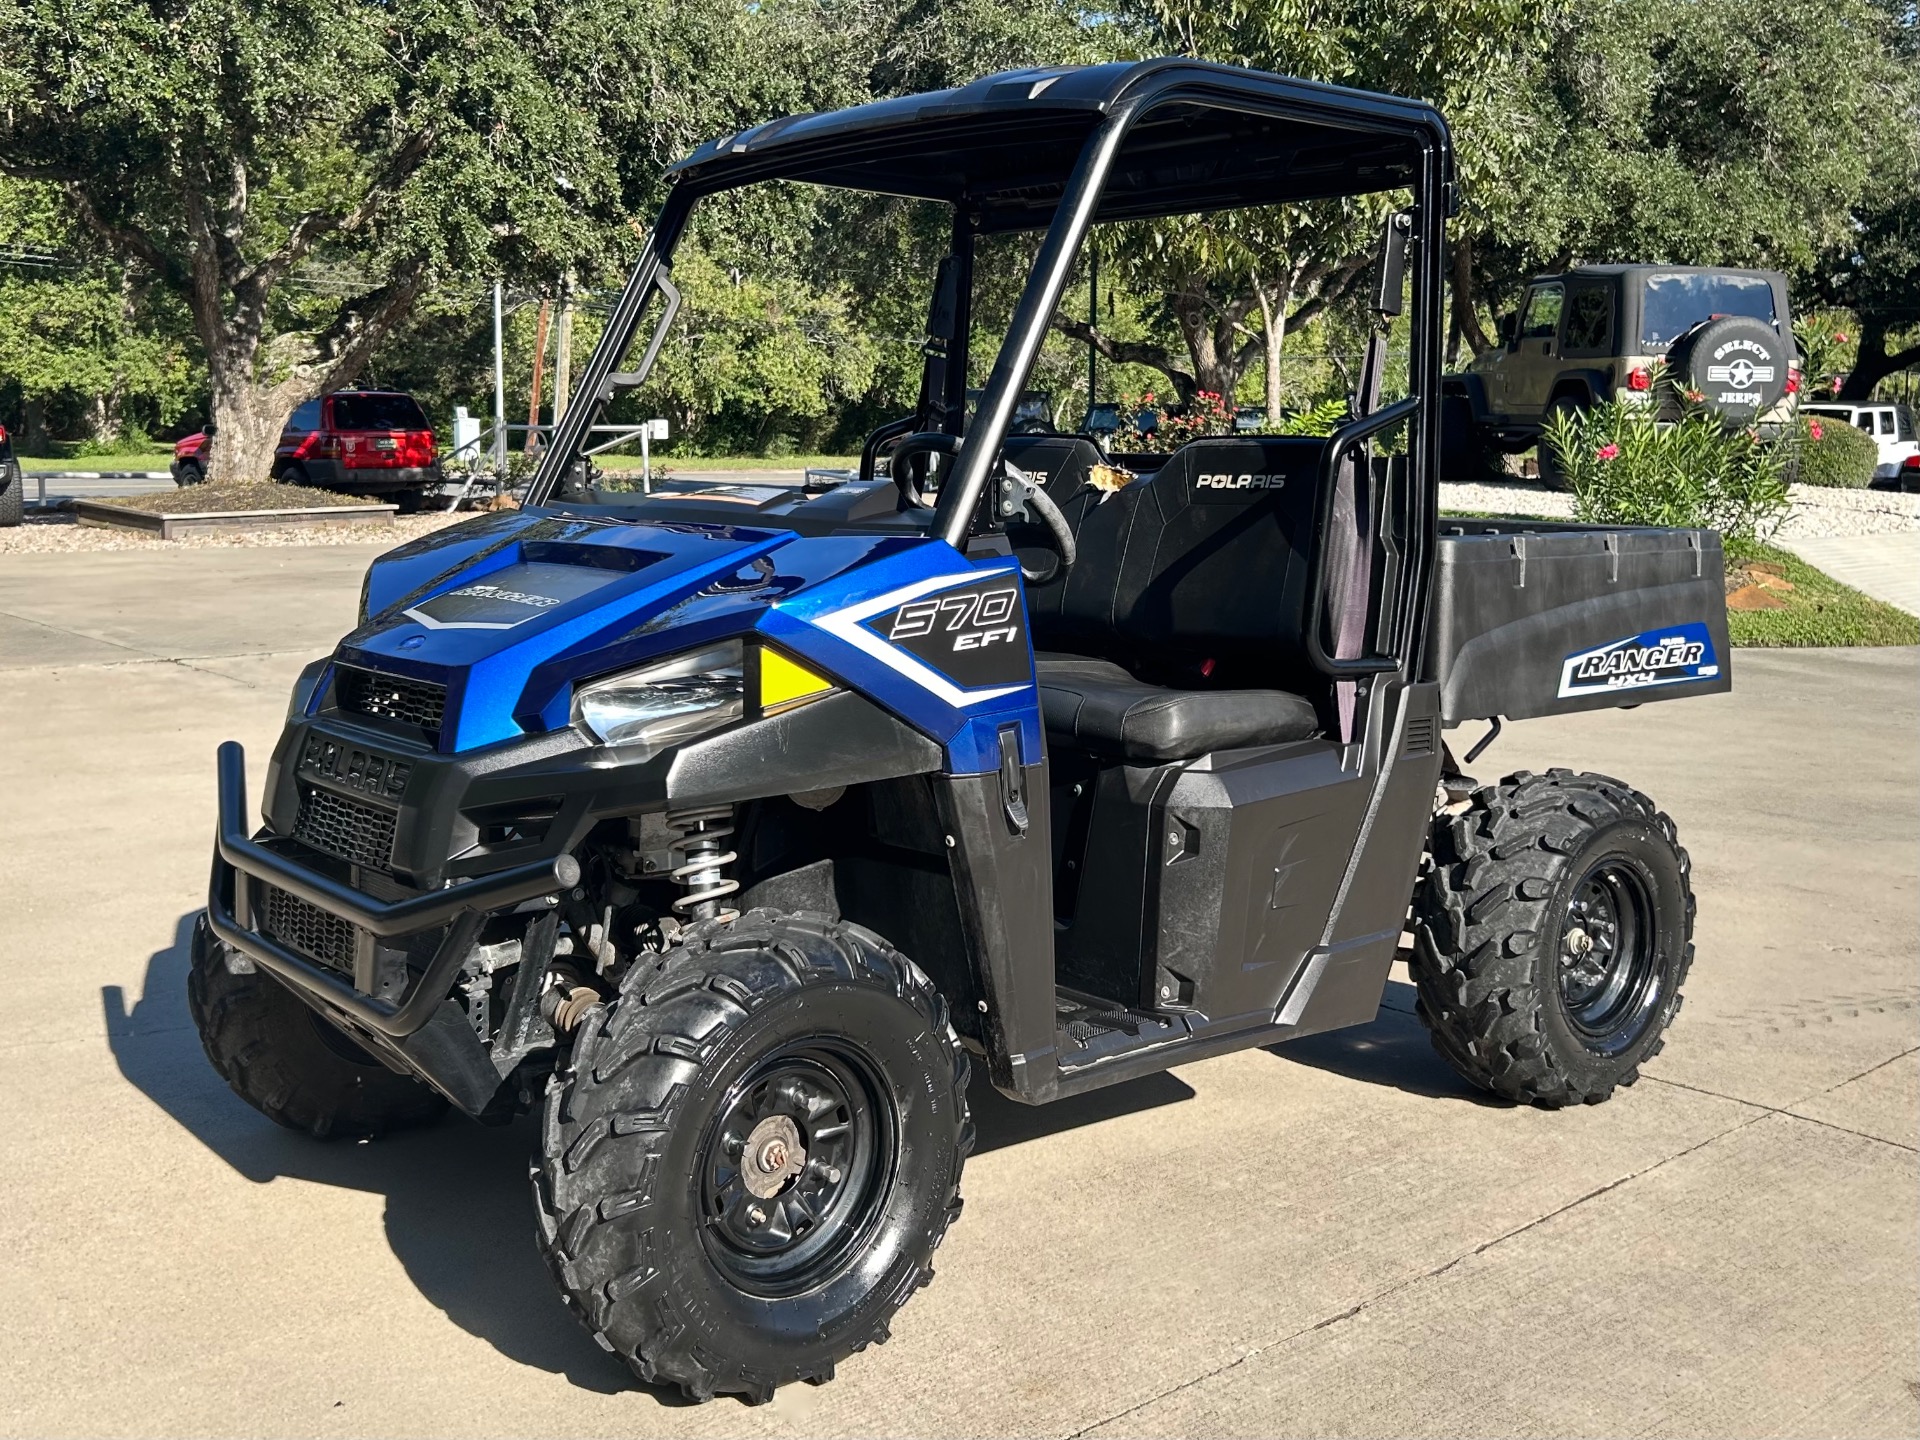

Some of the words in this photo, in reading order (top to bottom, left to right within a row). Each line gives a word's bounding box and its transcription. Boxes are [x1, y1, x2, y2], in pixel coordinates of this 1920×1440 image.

[1713, 339, 1771, 361] SELECT
[1718, 392, 1762, 407] JEEPS
[1196, 474, 1287, 489] POLARIS
[889, 588, 1017, 640] 570
[952, 626, 1018, 652] EFI
[1577, 642, 1704, 679] RANGER
[299, 734, 414, 801] POLARIS
